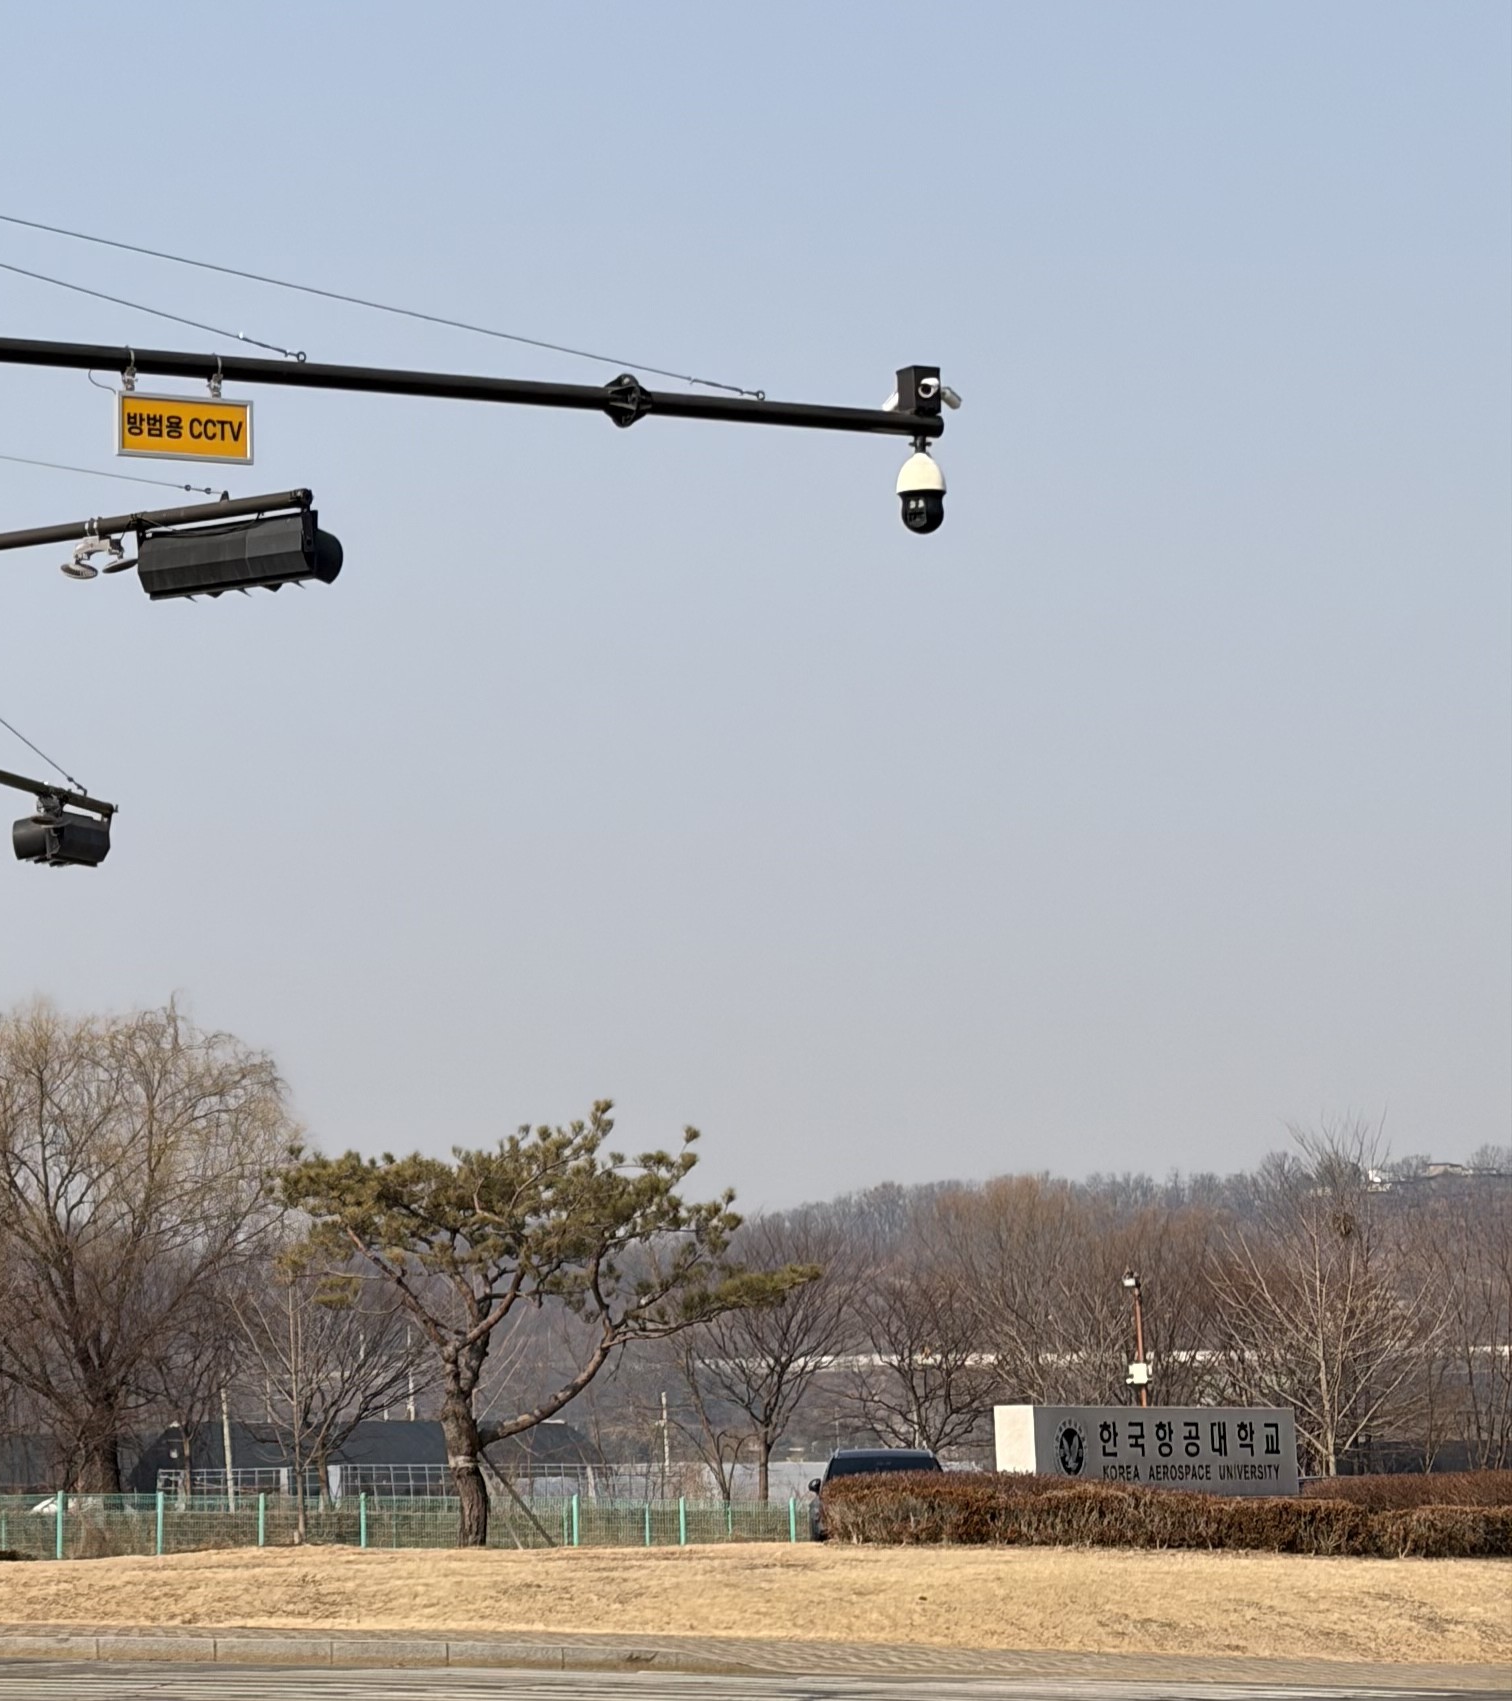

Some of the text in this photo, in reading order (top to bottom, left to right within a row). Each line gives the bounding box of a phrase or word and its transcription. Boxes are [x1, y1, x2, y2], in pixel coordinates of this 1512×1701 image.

[127, 412, 243, 441] 방범용 CCTV
[1099, 1421, 1280, 1457] 한국항공대학교
[1103, 1464, 1280, 1481] KOREA AEROSPACE UNIVERSITY
